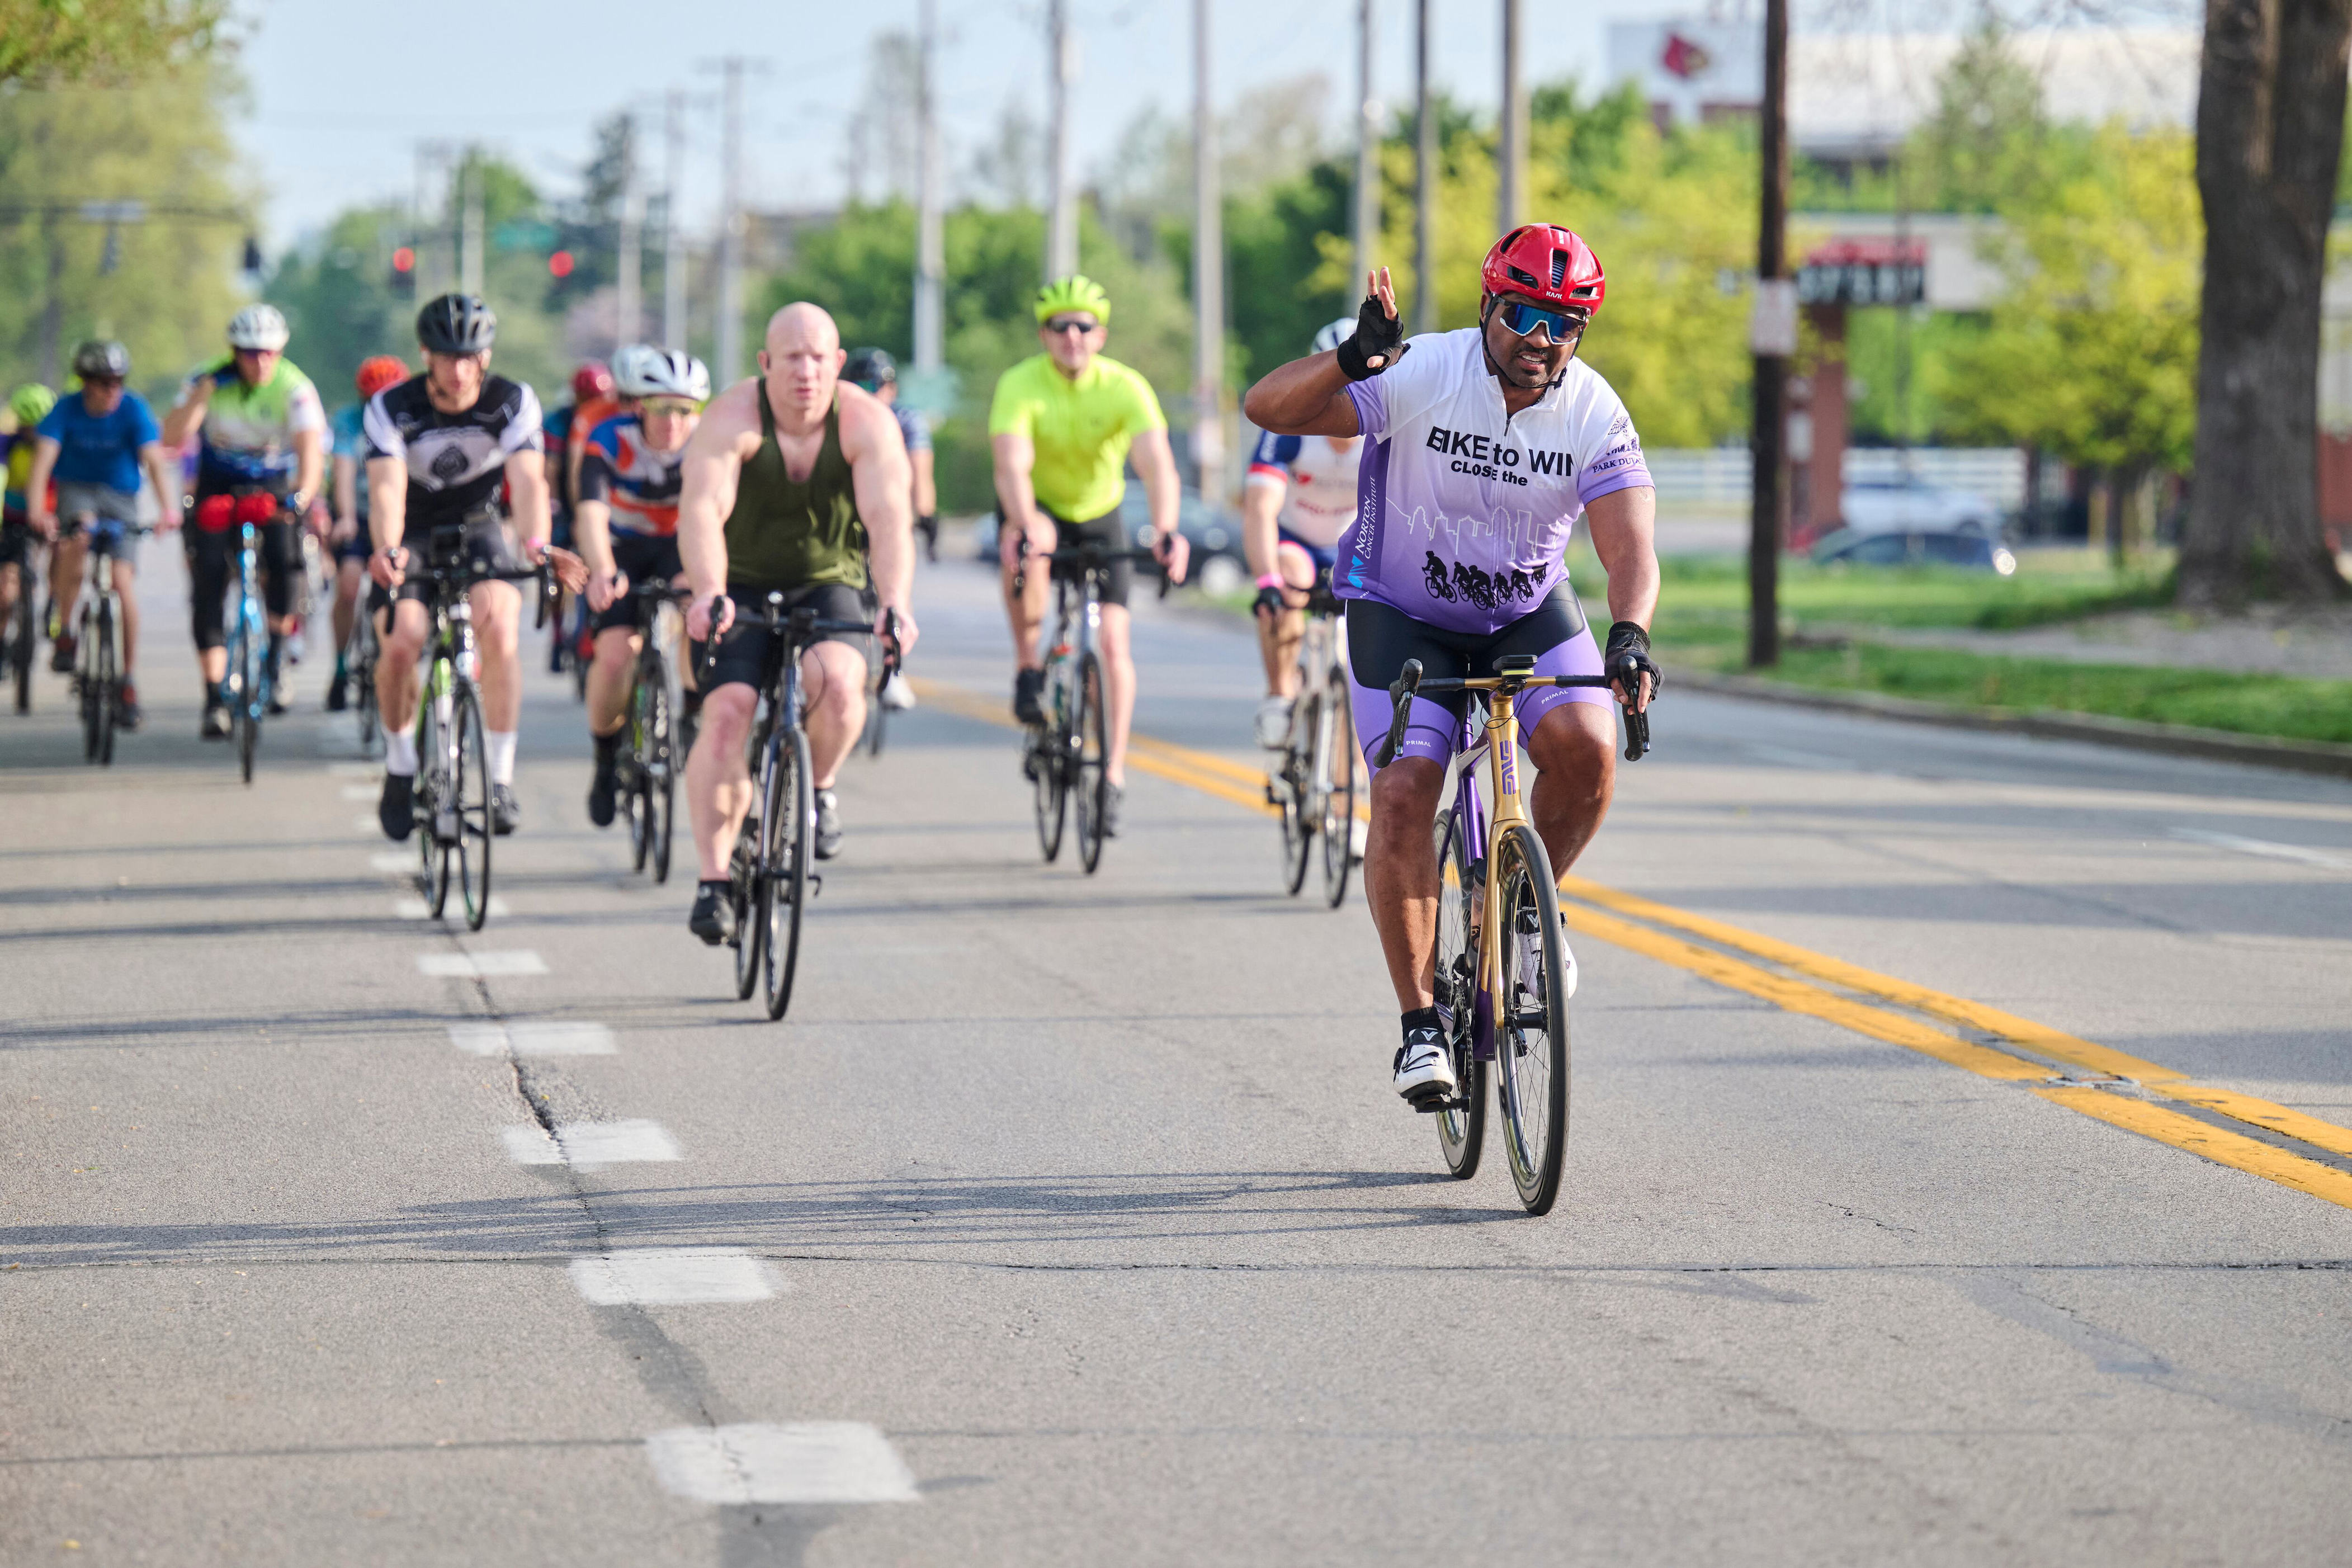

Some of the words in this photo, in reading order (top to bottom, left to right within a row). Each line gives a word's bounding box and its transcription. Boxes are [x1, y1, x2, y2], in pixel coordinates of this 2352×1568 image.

[1546, 290, 1562, 300] KASK
[1426, 426, 1490, 461] BIKE
[1493, 443, 1519, 467] to
[1451, 460, 1498, 481] CLOSE
[1502, 470, 1528, 486] the
[1592, 460, 1618, 473] PARK
[1355, 494, 1371, 555] NORTON
[1364, 525, 1375, 559] CANCER
[1541, 689, 1569, 705] PRIMAL
